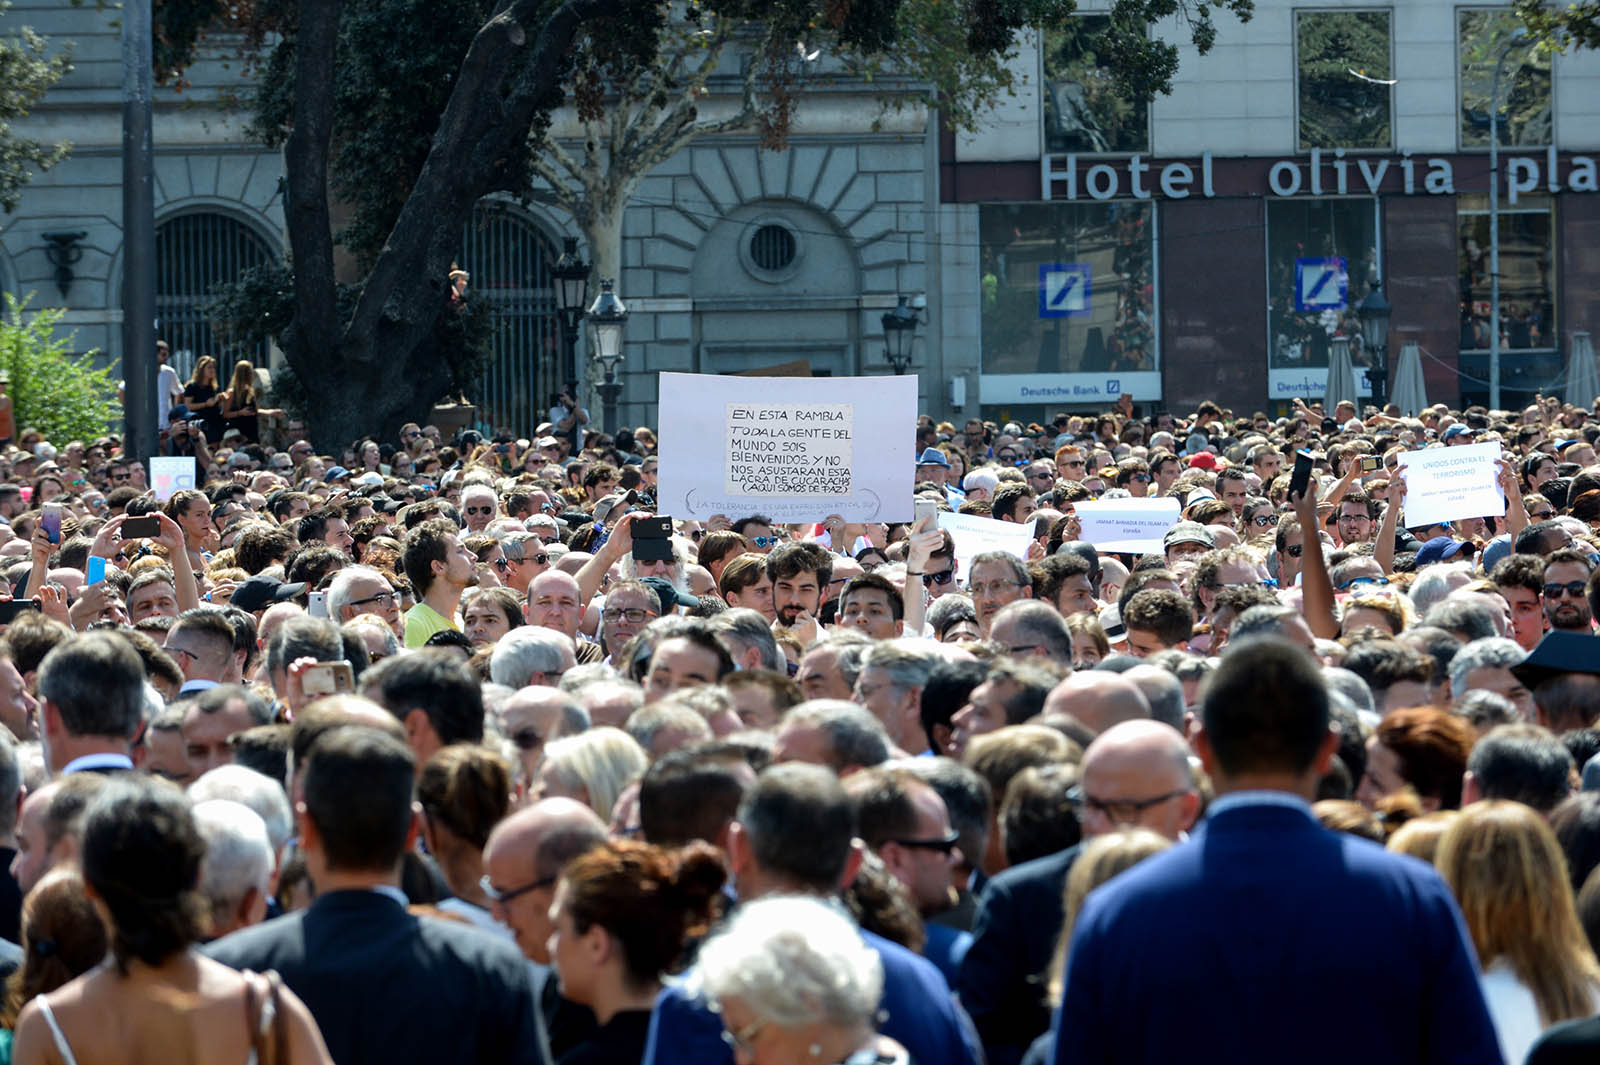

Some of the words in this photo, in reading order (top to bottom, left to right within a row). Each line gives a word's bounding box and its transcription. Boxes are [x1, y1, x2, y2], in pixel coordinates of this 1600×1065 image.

[1041, 152, 1215, 200] Hotel
[1269, 147, 1454, 196] olivia
[1508, 144, 1598, 204] pla
[1020, 386, 1070, 397] Deutsche
[1073, 385, 1100, 395] Bank
[732, 409, 754, 420] EN
[759, 410, 788, 421] ESTA
[796, 410, 844, 421] RAMBLA
[731, 426, 769, 437] TODA
[770, 428, 786, 437] LA
[788, 429, 831, 438] GENTE
[834, 429, 852, 440] DEL
[731, 439, 776, 451] MUNDO
[782, 442, 807, 452] SOIS
[813, 455, 823, 466] Y
[825, 455, 841, 466] NO
[1423, 460, 1449, 469] UNIDOS
[1450, 456, 1478, 466] CONTRA
[1478, 455, 1486, 463] EL
[731, 465, 754, 474] NOS
[758, 466, 825, 477] ASUSTARAN
[828, 468, 851, 477] ESTA
[1432, 468, 1476, 479] TERRORISMO
[731, 474, 770, 484] LACRA
[775, 476, 788, 485] DE
[742, 483, 776, 493] (AQUI
[778, 485, 807, 493] SOMOS
[809, 485, 820, 493] DE
[820, 486, 848, 494] PAZ)
